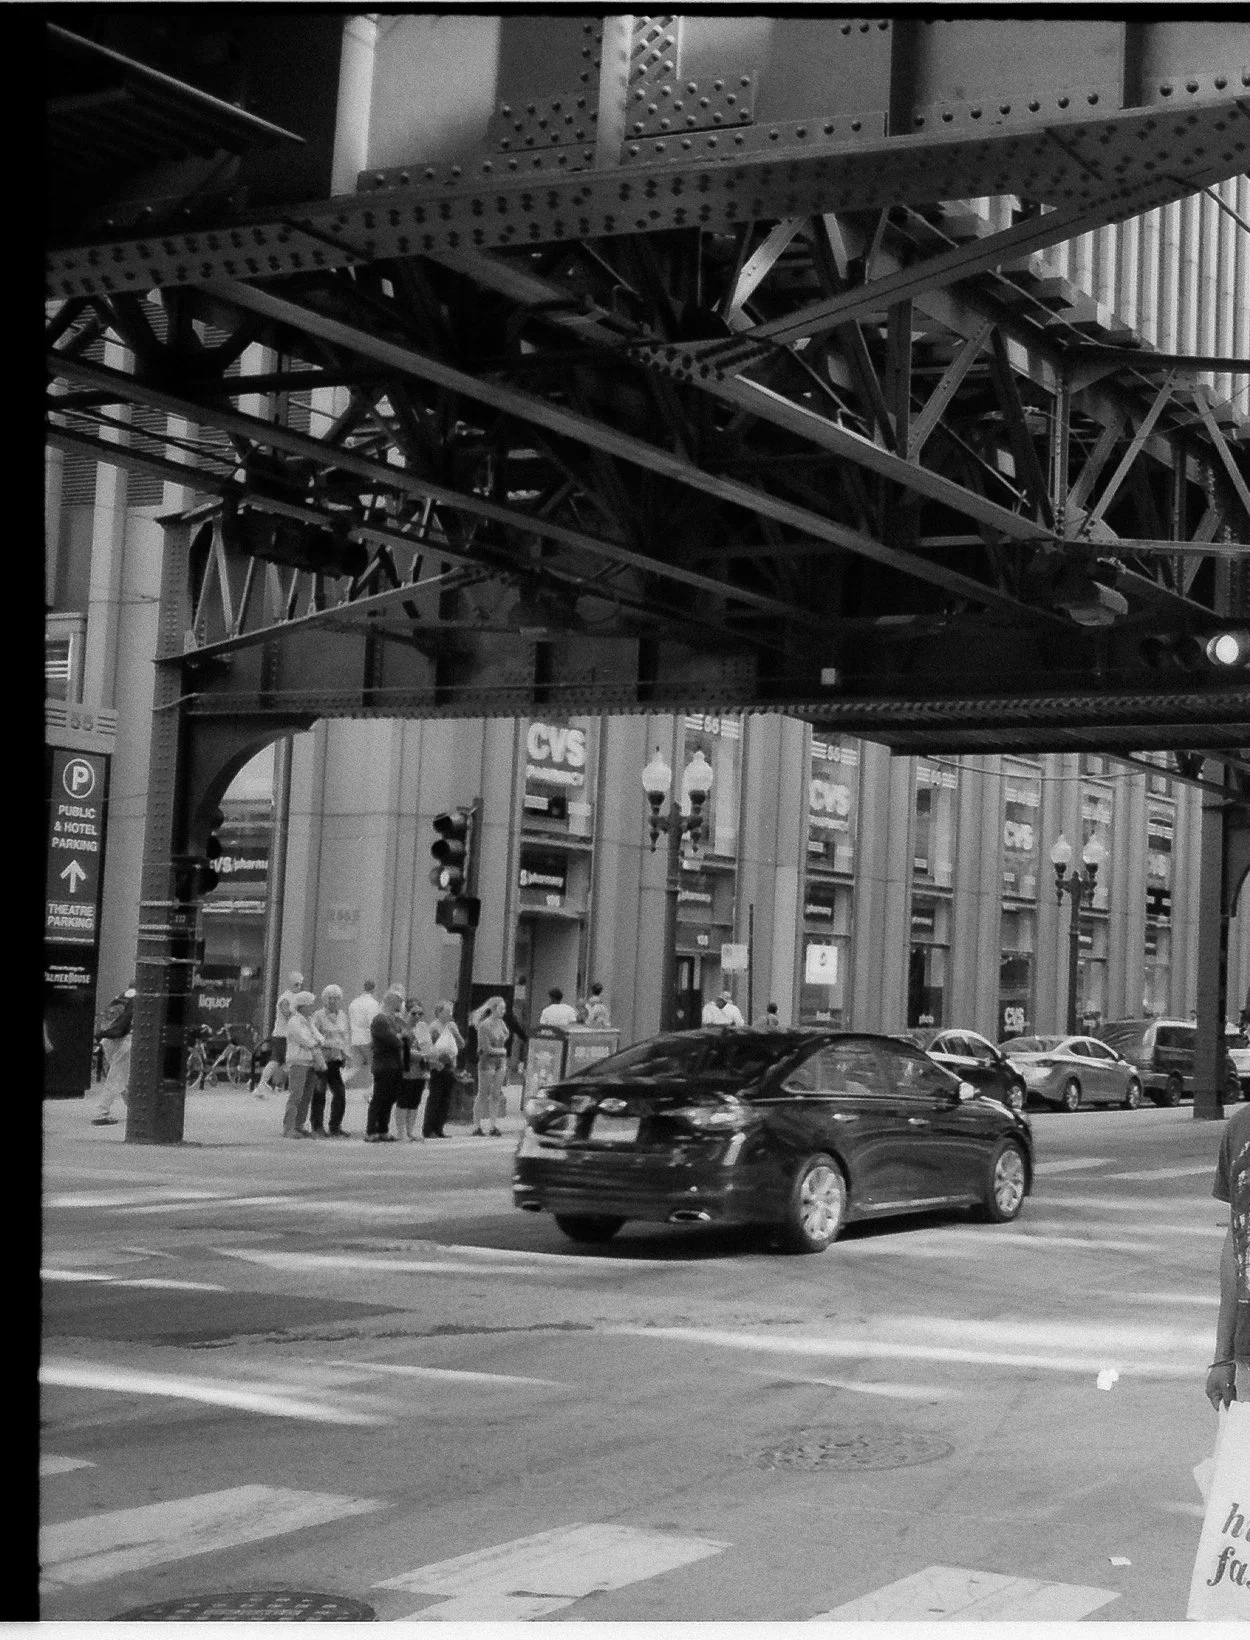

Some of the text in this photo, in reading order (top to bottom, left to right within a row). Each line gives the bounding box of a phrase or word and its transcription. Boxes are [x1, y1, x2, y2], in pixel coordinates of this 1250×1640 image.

[527, 722, 587, 767] CVS
[58, 804, 96, 819] PUBLIC
[53, 820, 98, 836] & HOTEL
[51, 836, 98, 852] PARKING
[47, 903, 95, 917] THEATRE
[47, 915, 95, 928] PARKING
